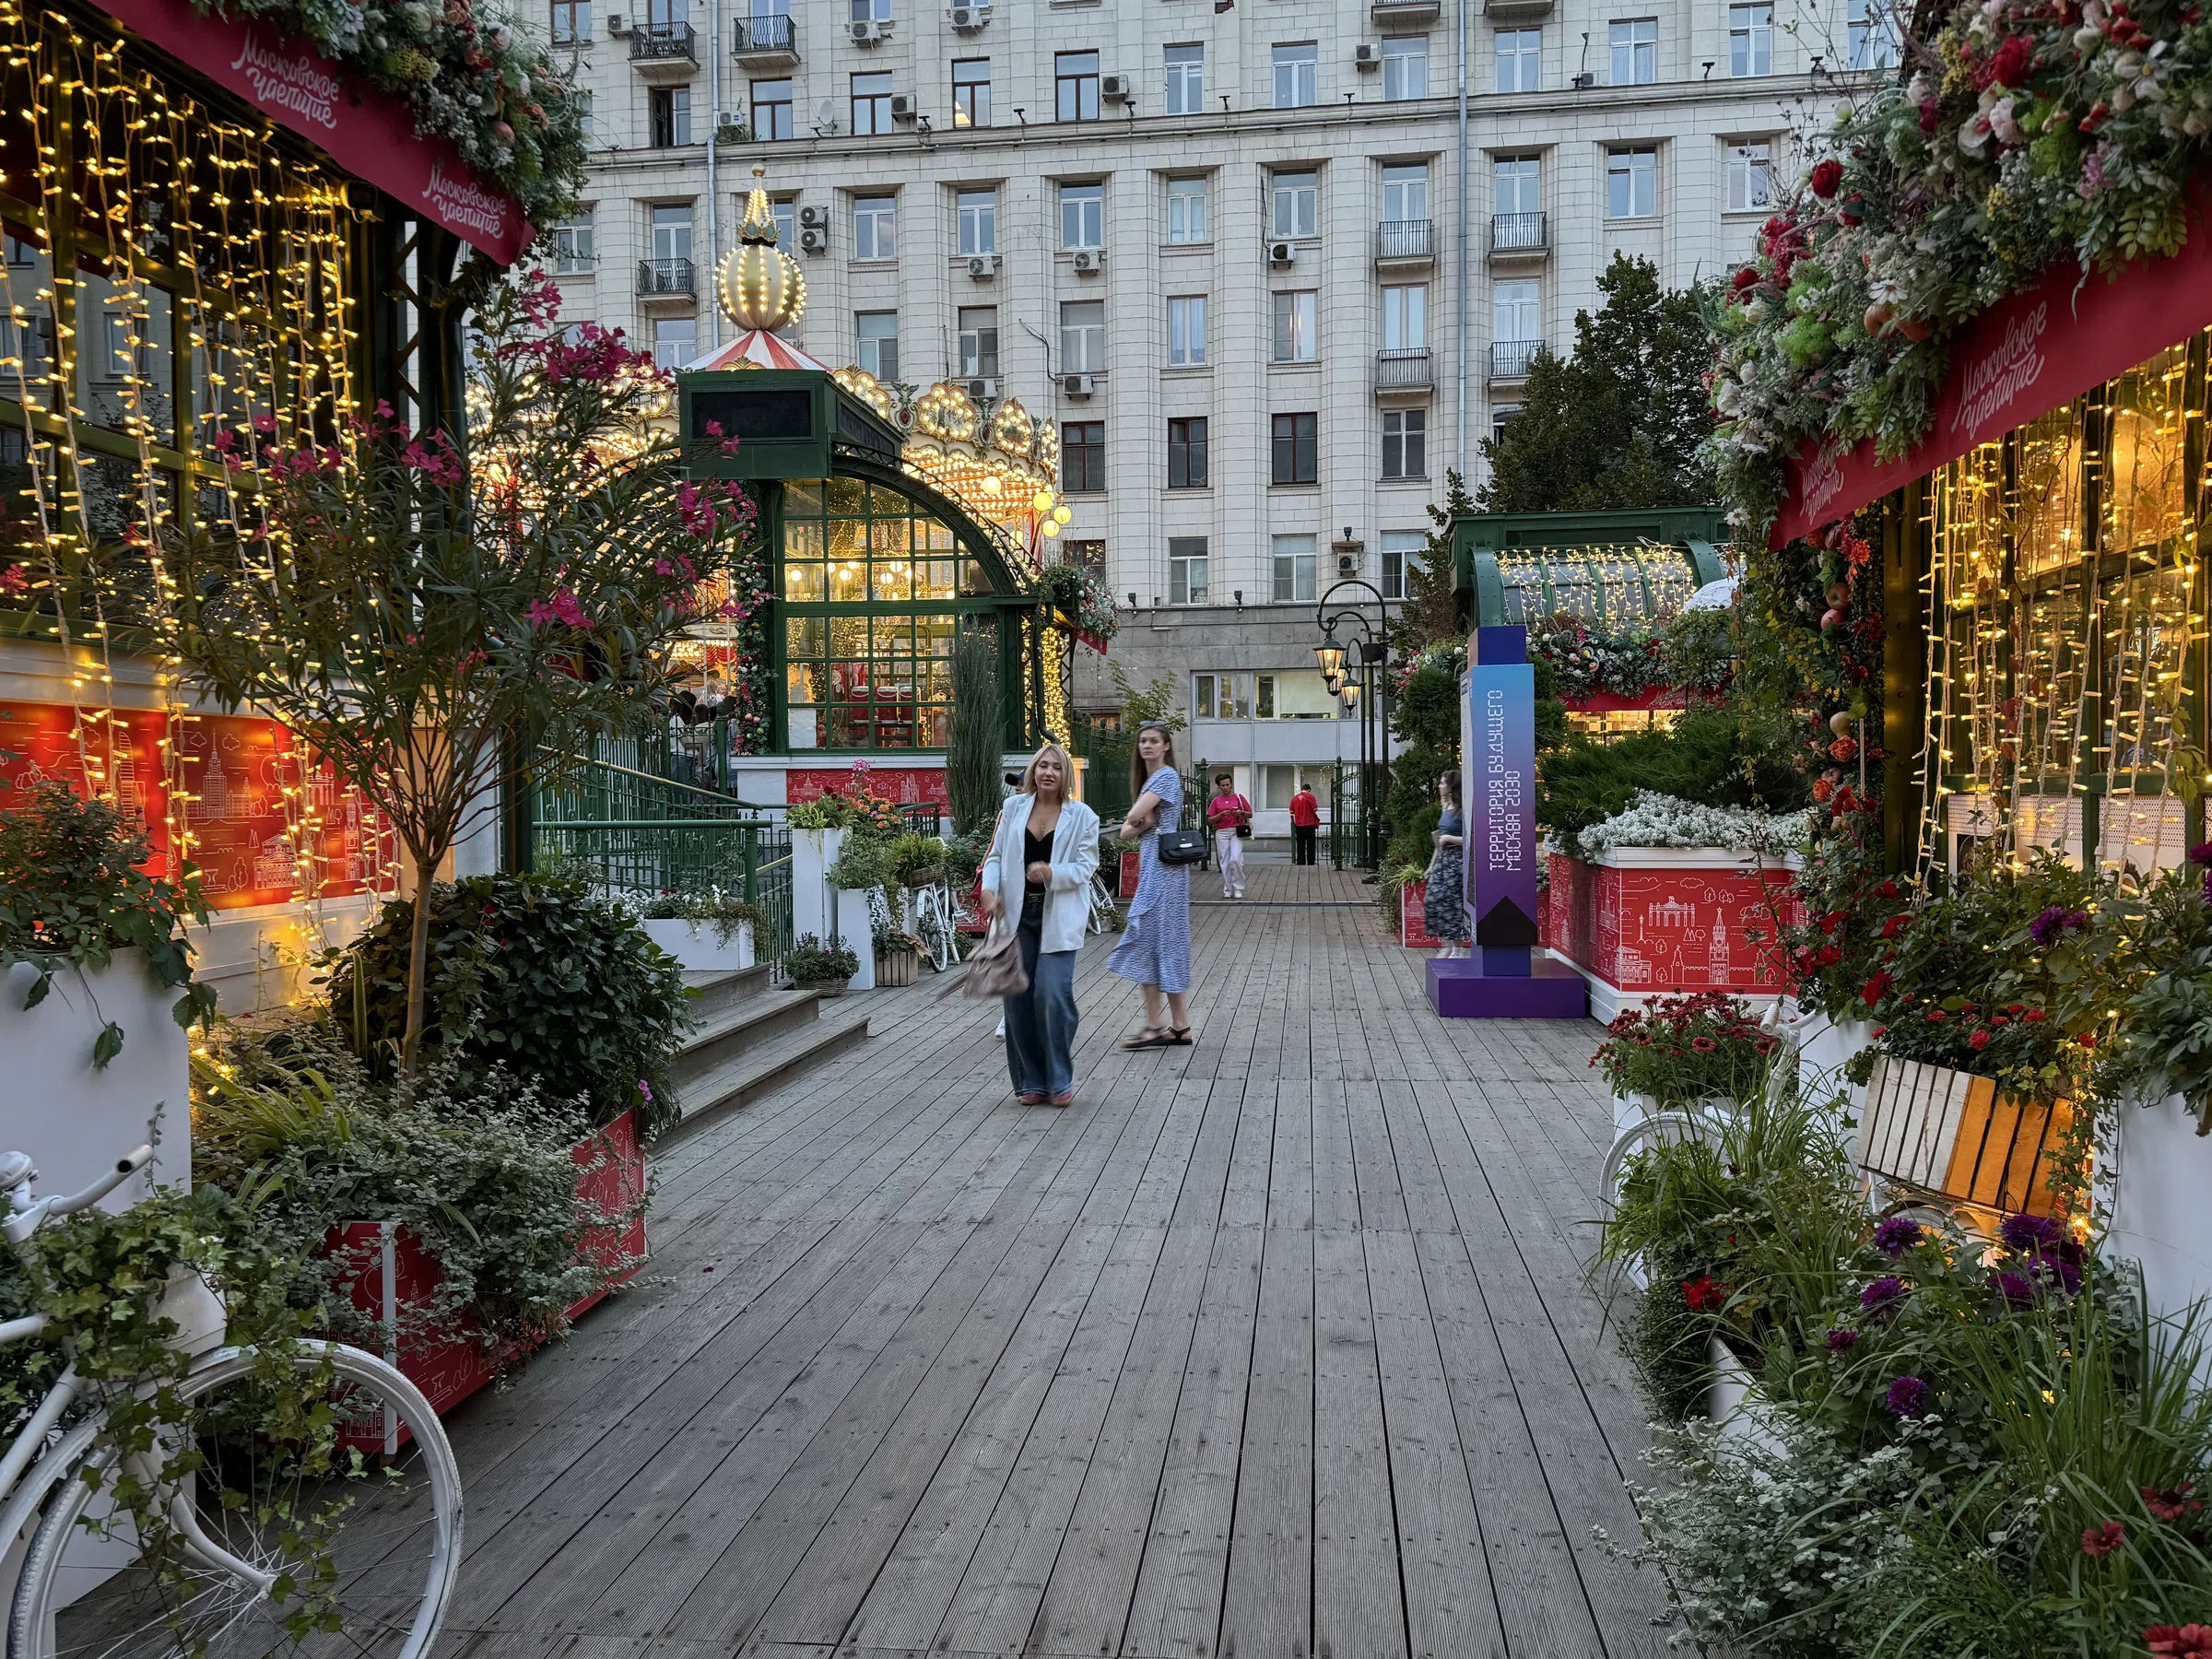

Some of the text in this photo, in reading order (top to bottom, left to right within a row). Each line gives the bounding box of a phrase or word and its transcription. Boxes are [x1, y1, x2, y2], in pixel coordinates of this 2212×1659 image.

[231, 29, 339, 101] Московское
[422, 162, 507, 215] Московское
[1950, 300, 2047, 433] Московское
[1488, 689, 1505, 871] ТЕРРИТОРИЯ БУДУЩЕГО
[1504, 771, 1522, 871] МОСКВА 2030
